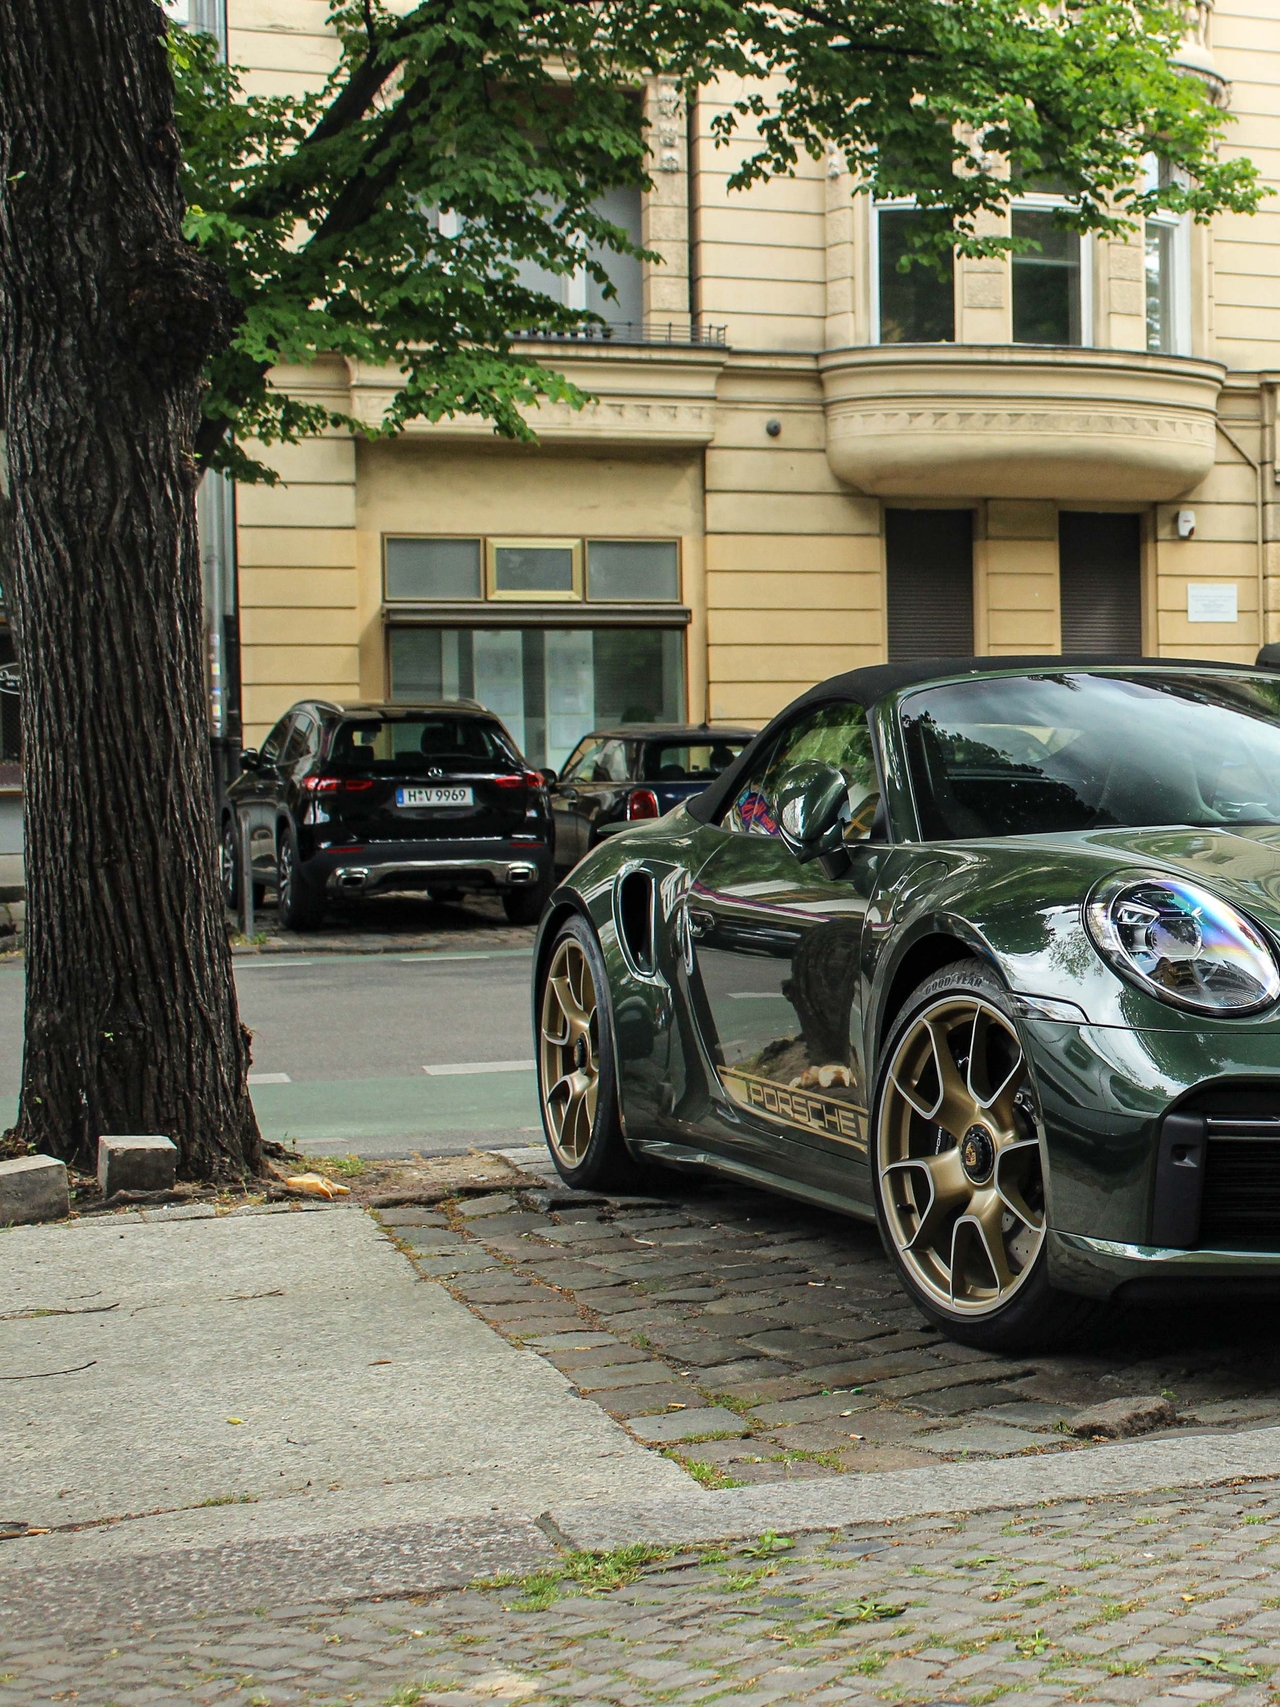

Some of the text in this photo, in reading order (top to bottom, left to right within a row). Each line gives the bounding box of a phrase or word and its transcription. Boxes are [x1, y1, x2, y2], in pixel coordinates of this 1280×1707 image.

[408, 789, 466, 802] H V 9969
[749, 1083, 857, 1138] PORSCHE
